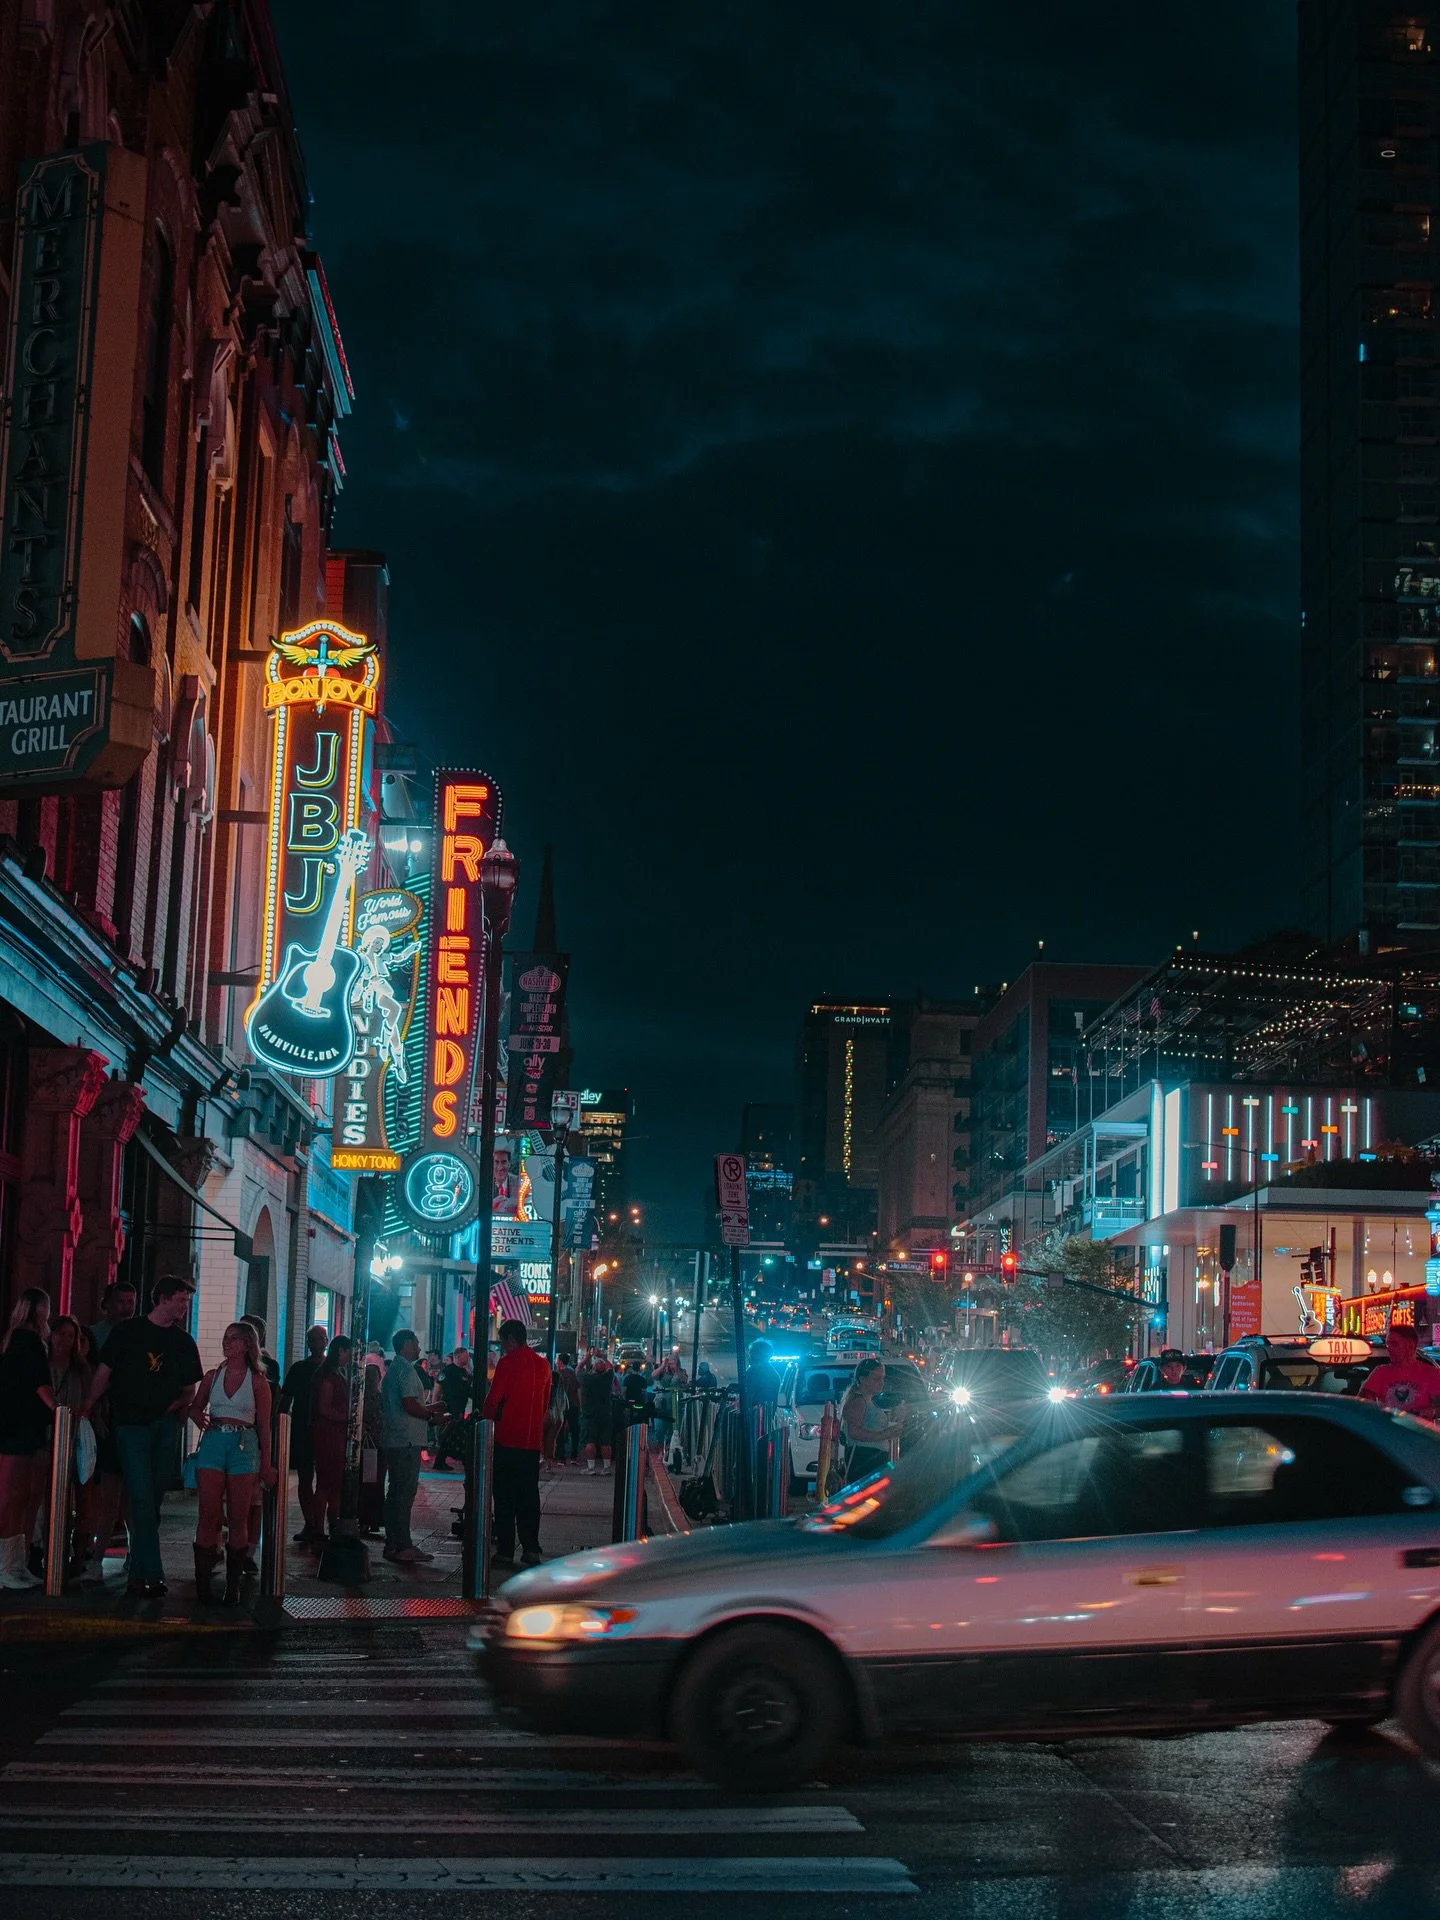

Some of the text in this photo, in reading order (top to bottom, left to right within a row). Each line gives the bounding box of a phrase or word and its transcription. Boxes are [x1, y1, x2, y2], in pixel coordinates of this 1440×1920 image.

[10, 173, 74, 639] MERCHANTS
[268, 677, 374, 709] BON JOVI
[0, 690, 93, 726] TAURANT
[11, 725, 70, 756] GRILL
[364, 894, 404, 914] World
[357, 907, 412, 931] Famous
[432, 783, 488, 1139] FRIENDS
[523, 1053, 546, 1070] ally
[343, 1013, 373, 1146] NUDIES
[333, 1153, 398, 1169] HONKY TONK
[1392, 1307, 1412, 1327] GIFTS
[1327, 1341, 1353, 1354] TAXI
